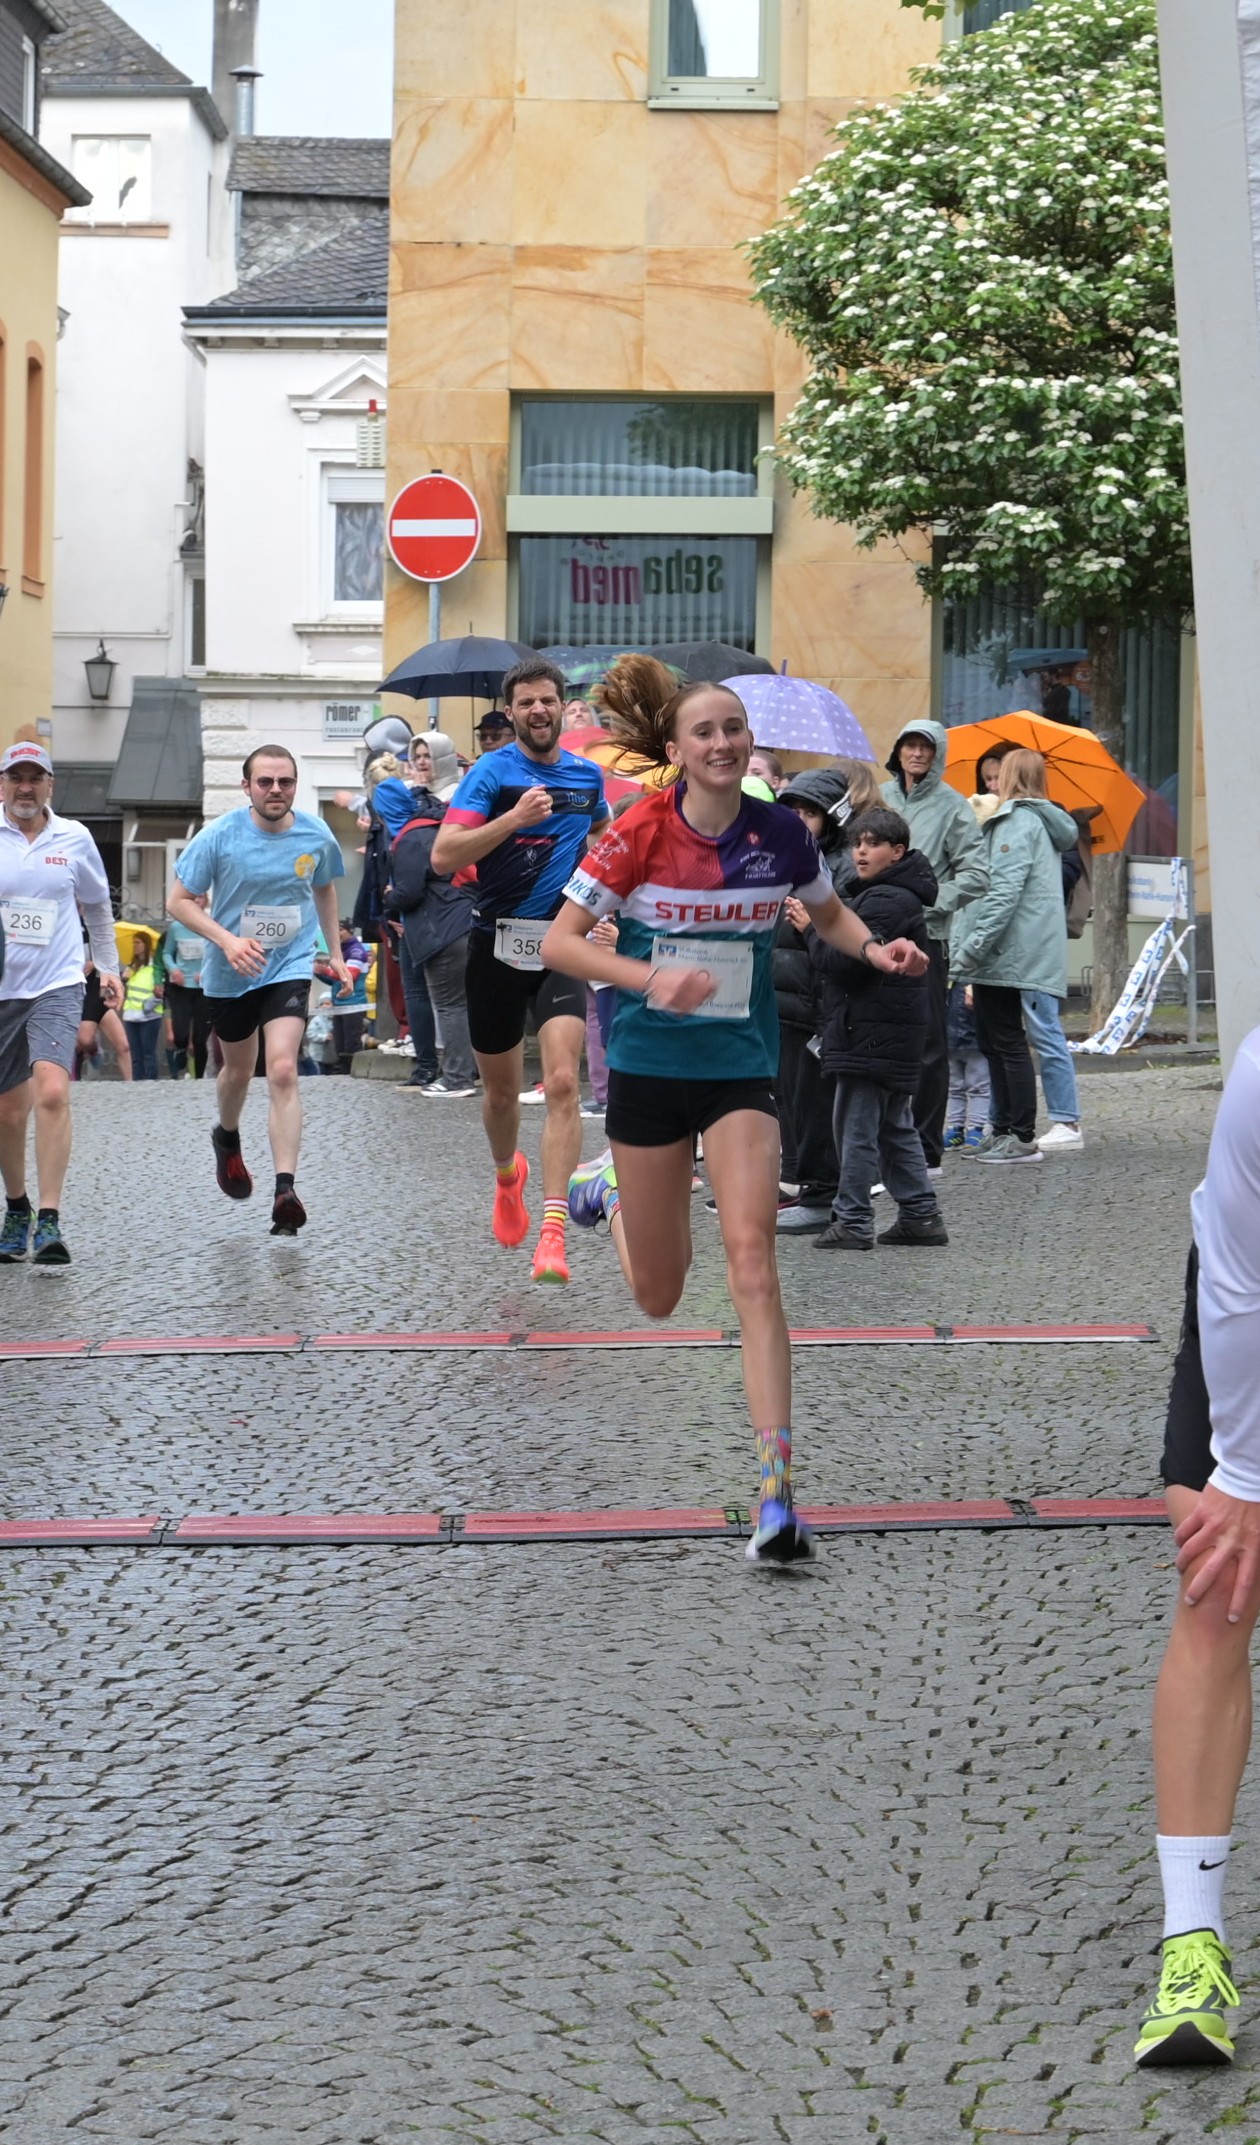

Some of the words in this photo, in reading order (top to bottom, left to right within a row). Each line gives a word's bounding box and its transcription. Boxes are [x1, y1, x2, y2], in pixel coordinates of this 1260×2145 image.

[325, 702, 361, 722] römer
[44, 856, 69, 866] BEST
[9, 913, 42, 931] 236
[255, 922, 287, 937] 260
